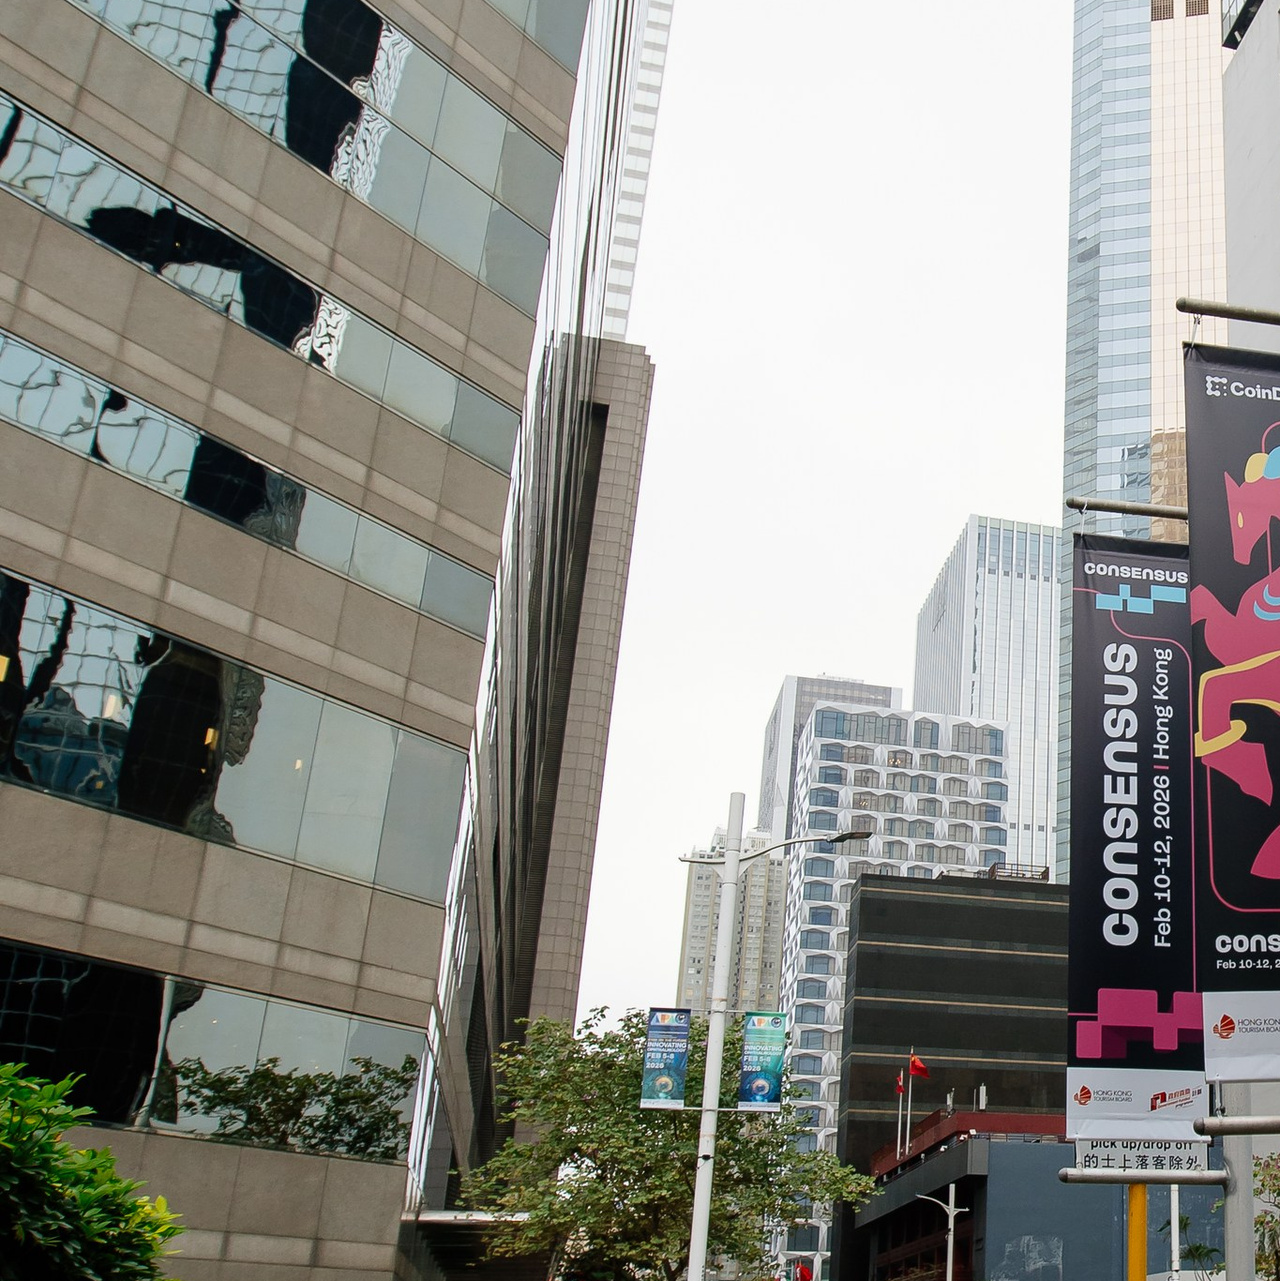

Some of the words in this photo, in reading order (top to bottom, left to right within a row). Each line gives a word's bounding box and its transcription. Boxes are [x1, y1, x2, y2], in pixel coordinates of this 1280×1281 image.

[1152, 647, 1173, 700] Kong
[1152, 704, 1174, 760] Hong
[1153, 775, 1170, 829] 2026
[1153, 835, 1173, 903] 10-12,
[1153, 907, 1172, 948] Feb
[1216, 959, 1237, 969] Feb
[1238, 959, 1273, 970] 10-12,
[1237, 1018, 1263, 1027] HONG
[1238, 1026, 1265, 1034] TOURISM
[647, 1041, 687, 1049] INNOVATING
[1083, 1153, 1199, 1172] 的士上落客除外
